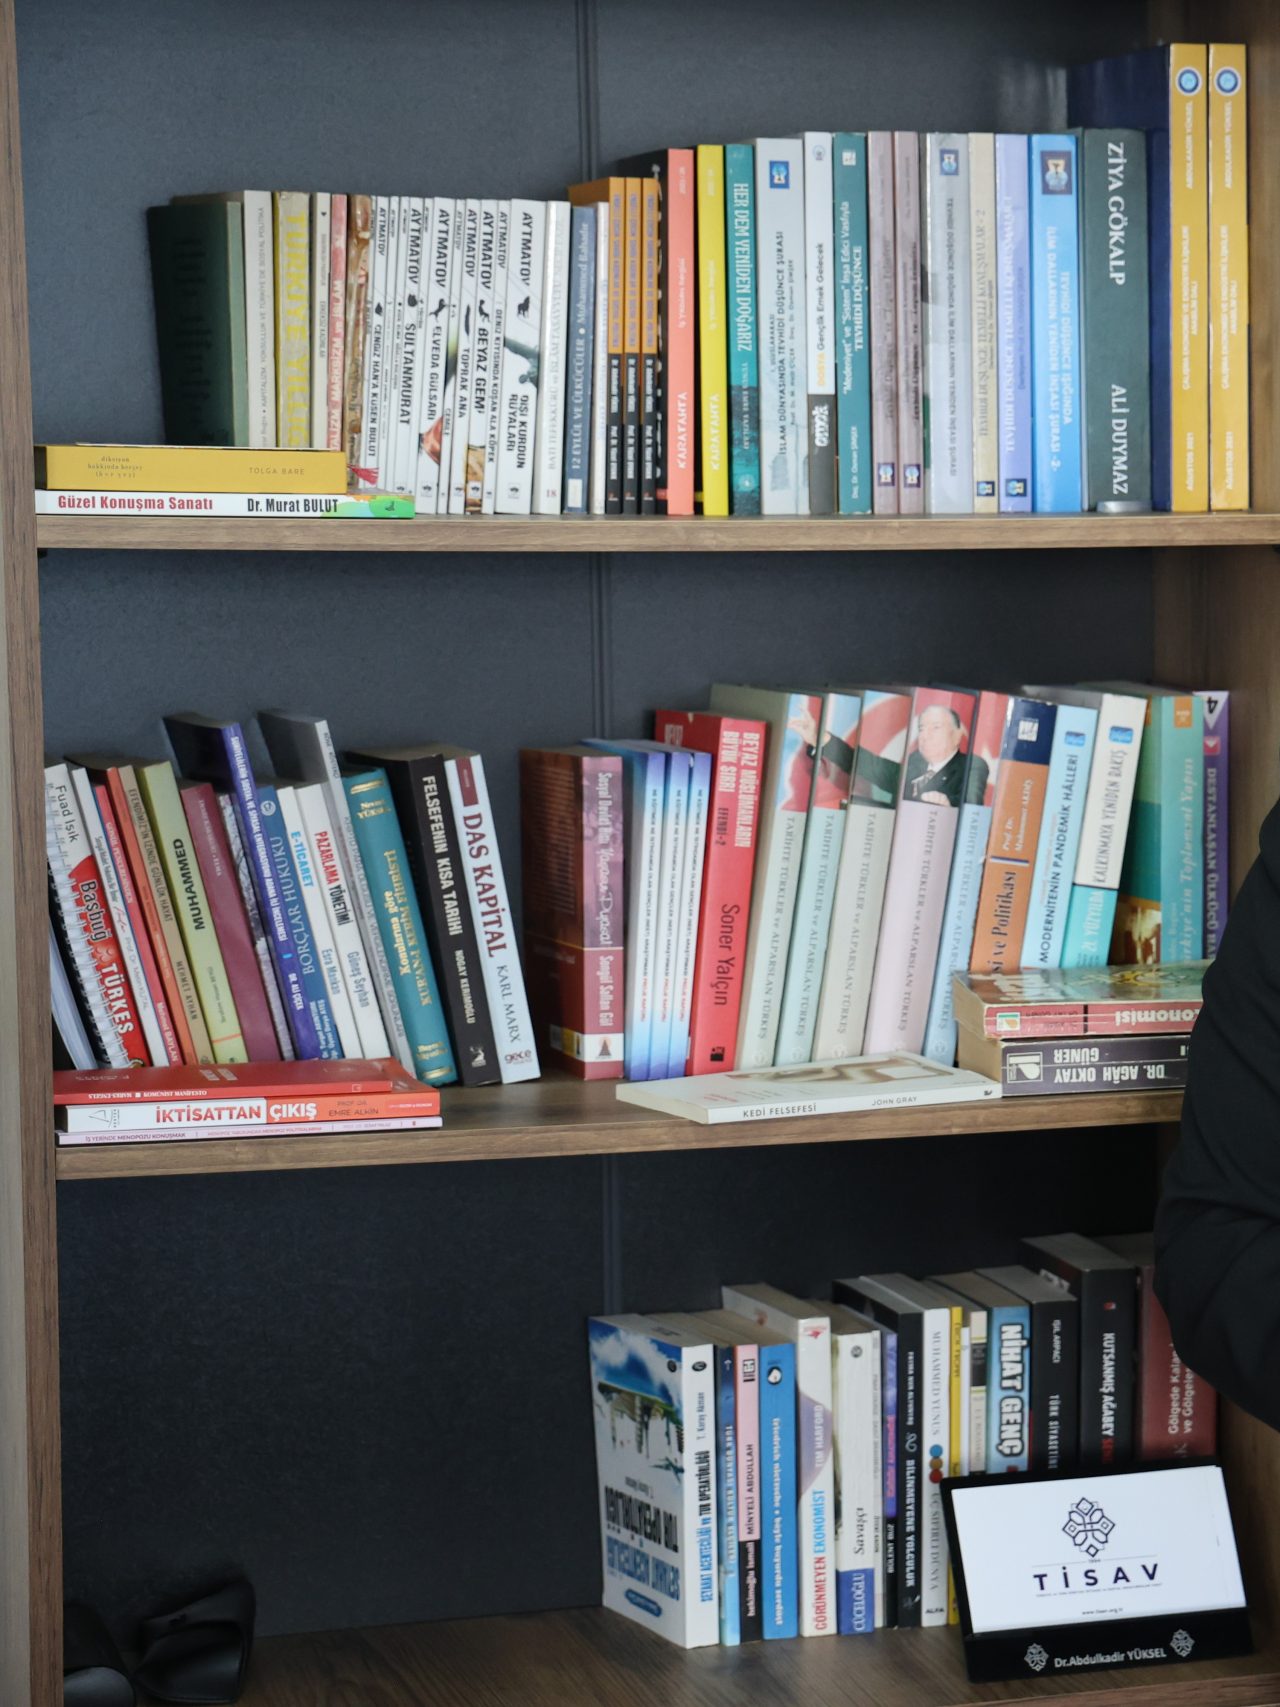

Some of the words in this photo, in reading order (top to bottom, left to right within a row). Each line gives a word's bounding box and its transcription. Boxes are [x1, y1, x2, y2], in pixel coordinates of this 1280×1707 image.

[1107, 142, 1127, 190] ZİYA
[733, 183, 749, 207] HER
[465, 209, 477, 277] AYTMATOV
[497, 211, 508, 268] AYTMATOV
[734, 210, 749, 236] DEM
[1108, 196, 1127, 285] GÖKALP
[408, 208, 422, 284] AYTMATOV
[435, 208, 450, 287] AYTMATOV
[481, 211, 494, 289] AYTMATOV
[520, 212, 533, 286] AYTMATOV
[734, 239, 752, 295] YENİDEN
[776, 231, 785, 265] ŞURASI
[816, 243, 824, 282] Gelecek
[577, 264, 588, 323] Muhammed
[776, 268, 786, 314] DÜŞÜNCE
[852, 246, 864, 301] DÜŞÜNCE
[1060, 271, 1072, 313] TEVHİDİ
[816, 285, 825, 311] Emek
[734, 297, 753, 351] DOĞARIZ
[777, 317, 786, 355] TEVHİDİ
[816, 315, 826, 351] Gençlik
[853, 304, 864, 350] TEVHİDİ
[1060, 317, 1073, 371] DÜŞÜNCE
[430, 326, 442, 368] ELVEDA
[476, 328, 488, 371] BEYAZ
[492, 337, 501, 381] KIYISINDA
[399, 323, 417, 425] SULTANMURAT
[459, 348, 470, 391] TOPRAK
[571, 339, 586, 403] ÜLKÜCÜLER
[776, 358, 787, 420] DÜNYASINDA
[368, 392, 378, 424] KÜSEN
[427, 372, 439, 420] GÜLSARI
[458, 396, 468, 418] ANA
[490, 384, 498, 412] KOŞAN
[573, 406, 583, 419] VE
[1110, 384, 1128, 413] ALİ
[368, 426, 378, 457] BULUT
[507, 394, 518, 451] RÜYALARI
[571, 422, 583, 455] EYLÜL
[677, 392, 687, 468] KARATAHTA
[710, 393, 720, 470] KARATAHTA
[487, 434, 496, 463] KÖPEK
[516, 421, 528, 469] KURDUN
[572, 458, 580, 469] 12
[1111, 418, 1128, 495] DUYMAZ
[58, 496, 96, 508] Güzel
[100, 497, 164, 512] Konuşma
[169, 497, 213, 510] Sanatı
[247, 499, 262, 512] Dr.
[266, 499, 300, 512] Murat
[304, 499, 339, 513] BULUT
[721, 730, 739, 763] BÜYÜK
[741, 732, 760, 766] BEYAZ
[55, 784, 73, 817] Fuad
[597, 772, 612, 798] Sosyal
[719, 766, 737, 792] SIRRI
[422, 775, 448, 854] FELSEFENİN
[734, 769, 759, 848] MÜSLÜMANLARIN
[1206, 767, 1217, 870] DESTANLAŞAN
[63, 819, 80, 843] Işık
[462, 813, 489, 859] DAS
[269, 836, 298, 901] HUKUKU
[314, 830, 339, 885] PAZARLAMA
[435, 857, 455, 889] KISA
[1093, 824, 1115, 883] KALKINMAYA
[173, 838, 206, 930] MUHAMMED
[290, 831, 314, 887] E-TİCARET
[320, 949, 334, 967] Esra
[381, 890, 398, 913] göre
[915, 860, 933, 907] TÜRKLER
[991, 871, 1018, 937] Politikası
[1039, 872, 1061, 963] MODERNİTENİN
[1052, 805, 1072, 867] PANDEMİK
[1207, 873, 1220, 929] ÜLKÜCÜ
[79, 880, 111, 942] Başbuğ
[327, 885, 352, 926] YÖNETİMİ
[442, 893, 462, 936] TARİHİ
[472, 864, 508, 958] KAPİTAL
[717, 904, 740, 950] Soner
[141, 841, 158, 866] İZİNDE
[150, 867, 168, 899] GÜNLÜK
[159, 900, 174, 922] HAYAT
[174, 960, 190, 992] MEHMET
[183, 994, 198, 1021] AYHAN
[289, 905, 315, 974] BORÇLAR
[993, 940, 1007, 956] ve
[345, 951, 364, 977] Güneş
[454, 950, 467, 977] NOGAY
[595, 955, 612, 982] Songül
[905, 925, 923, 986] ALPARSLAN
[351, 978, 371, 1007] Seyhan
[495, 965, 512, 1000] KARL
[598, 983, 614, 1010] Sallan
[709, 956, 736, 1006] Yalçın
[502, 1003, 521, 1044] MARX
[600, 1011, 615, 1027] Gül
[1054, 1048, 1099, 1064] GÜNER
[1054, 1065, 1096, 1083] OKTAY
[1102, 1065, 1138, 1084] AGÂH
[1142, 1065, 1165, 1079] DR.
[155, 1104, 261, 1124] İKTİSATTAN
[269, 1102, 318, 1122] ÇIKIŞ
[743, 1107, 766, 1118] KEDİ
[769, 1103, 817, 1116] FELSEFESİ
[872, 1098, 893, 1106] JOHN
[896, 1096, 918, 1105] GRAY
[930, 1330, 941, 1395] MUHAMMED
[999, 1324, 1027, 1391] NİHAT
[1052, 1334, 1060, 1363] ARPACI
[1099, 1333, 1116, 1392] KUTSANMIŞ
[812, 1405, 825, 1448] HARFORD
[930, 1398, 941, 1435] YUNUS
[996, 1397, 1022, 1456] GENÇ
[1048, 1395, 1060, 1417] TÜRK
[1101, 1395, 1117, 1436] AĞABEY
[1167, 1387, 1181, 1434] Gölgede
[745, 1444, 756, 1493] ABDULLAH
[814, 1452, 824, 1468] TIM
[745, 1496, 756, 1535] MİNYELİ
[905, 1460, 916, 1532] BİLİNMEYENE
[810, 1490, 826, 1553] EKONOMİST
[852, 1507, 868, 1555] Savaşçı
[745, 1542, 757, 1569] ismail
[905, 1534, 916, 1587] YOLCULUK
[929, 1551, 941, 1590] DÜNYA
[1033, 1563, 1159, 1591] TİSAV
[745, 1571, 757, 1616] hekimoğlu
[812, 1556, 828, 1630] GÖRÜNMEYEN
[850, 1573, 867, 1631] CÜCELOĞLU
[1054, 1652, 1125, 1669] Dr.Abdulkadir
[1127, 1647, 1167, 1661] YÜKSEL
